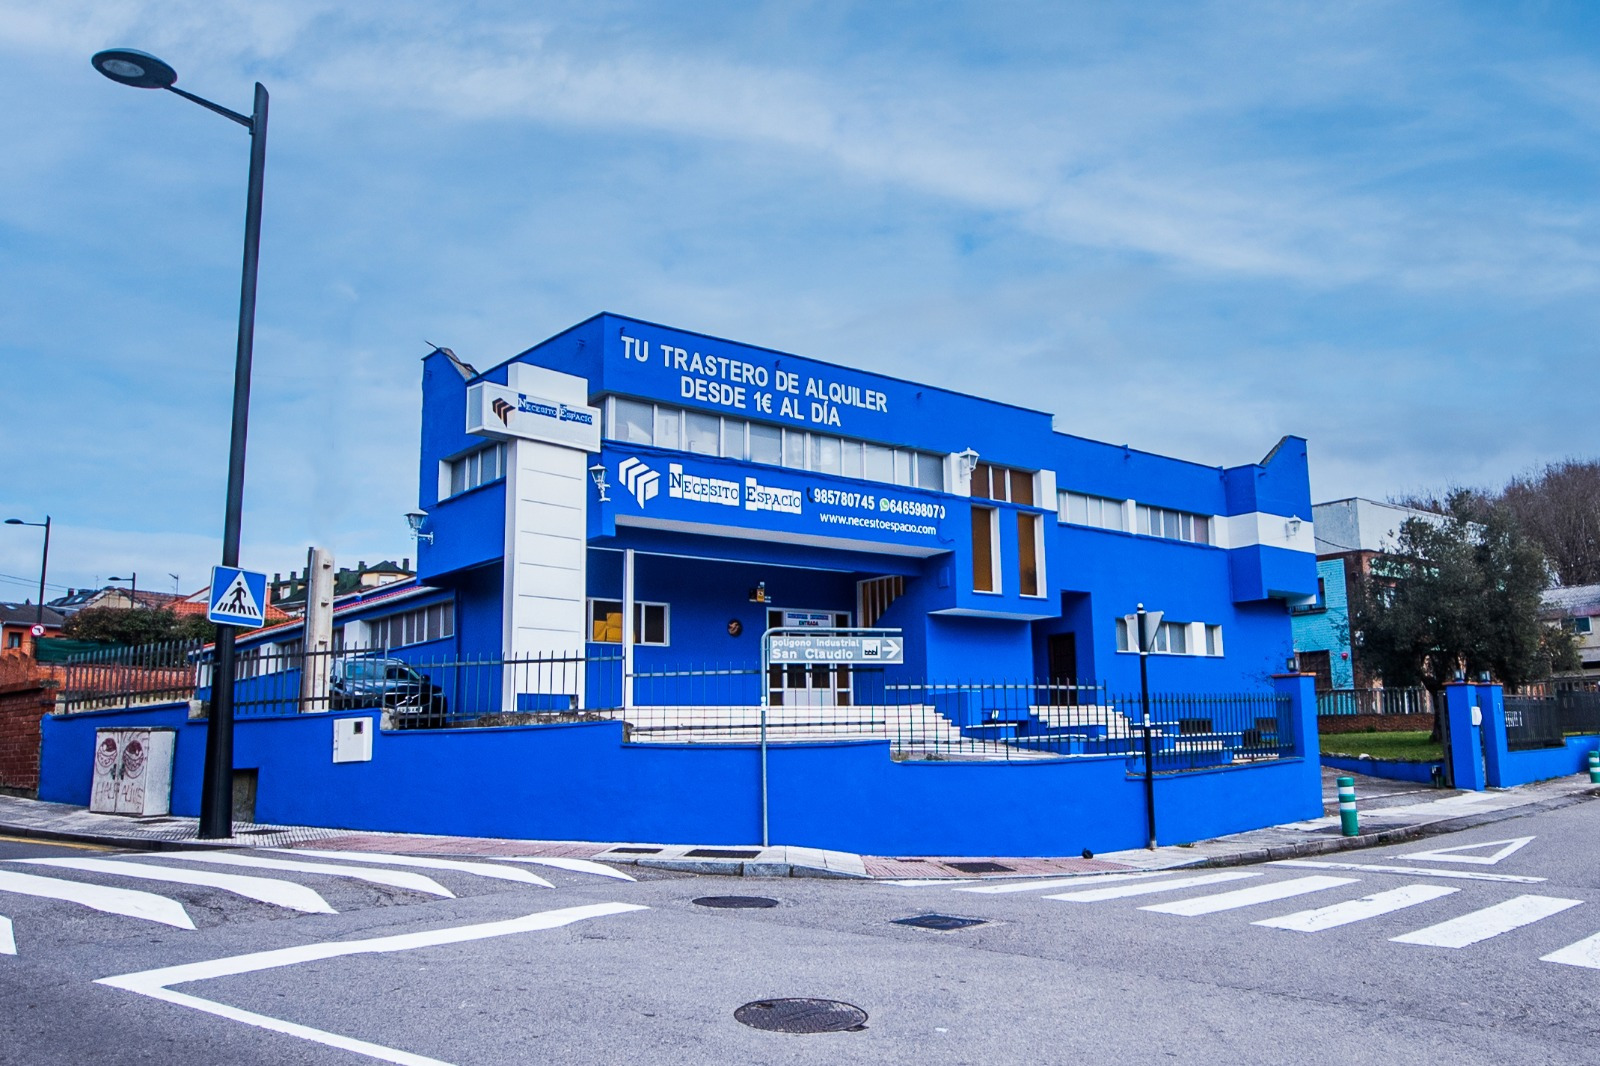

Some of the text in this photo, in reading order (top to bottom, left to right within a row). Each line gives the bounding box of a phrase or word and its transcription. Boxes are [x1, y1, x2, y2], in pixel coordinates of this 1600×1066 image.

[621, 335, 888, 413] TU TRASTERO DE ALQUILER
[681, 375, 841, 427] DESDE 1€ AL DÍA
[813, 487, 946, 520] 985780745 646598070
[819, 512, 937, 536] www.necesitoespacio.com
[772, 648, 854, 659] San Claudio
[816, 638, 860, 647] industrial
